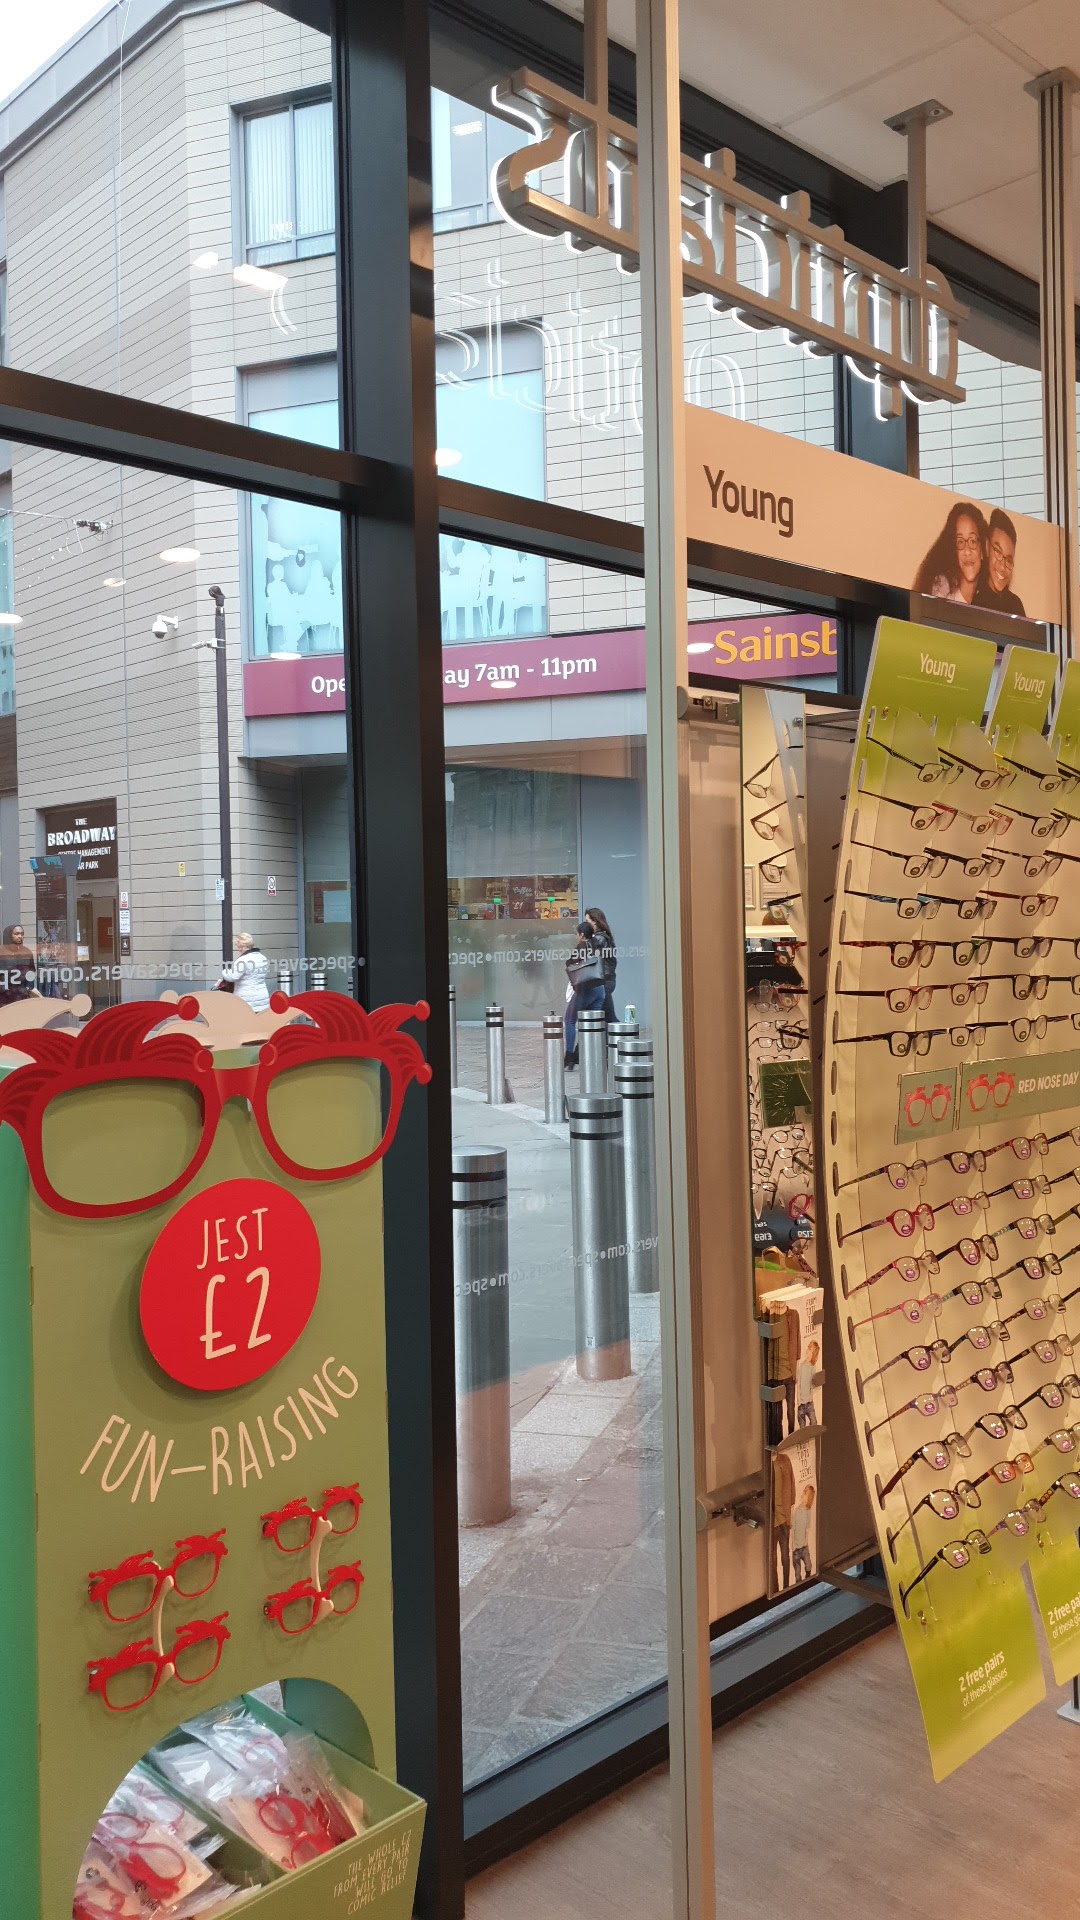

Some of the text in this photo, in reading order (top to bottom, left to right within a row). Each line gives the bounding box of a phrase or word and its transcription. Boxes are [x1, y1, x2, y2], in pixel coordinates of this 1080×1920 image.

[702, 464, 794, 539] Young
[475, 663, 520, 682] 7am
[540, 657, 597, 680] 11pm
[920, 652, 956, 684] Young
[1014, 672, 1046, 699] Young
[47, 825, 117, 847] BROADWAY
[74, 818, 88, 826] THE
[85, 860, 99, 870] PARK
[1018, 1071, 1080, 1094] RED NOSE DAY
[197, 1207, 269, 1270] JEST
[199, 1266, 272, 1360] £2
[1047, 1610, 1055, 1626] 2
[1053, 1602, 1071, 1621] free
[1052, 1626, 1059, 1639] of
[1058, 1618, 1075, 1635] these
[958, 1650, 1005, 1693] 2 free pairs
[962, 1692, 970, 1707] of
[969, 1683, 988, 1702] these
[986, 1667, 1008, 1692] glasses
[333, 1843, 410, 1898] FROM EVERY PAIR
[348, 1858, 362, 1876] THE
[368, 1838, 396, 1865] WHOLE
[347, 1869, 407, 1916] COMIC RELIEF
[356, 1857, 409, 1898] WILL GO TO
